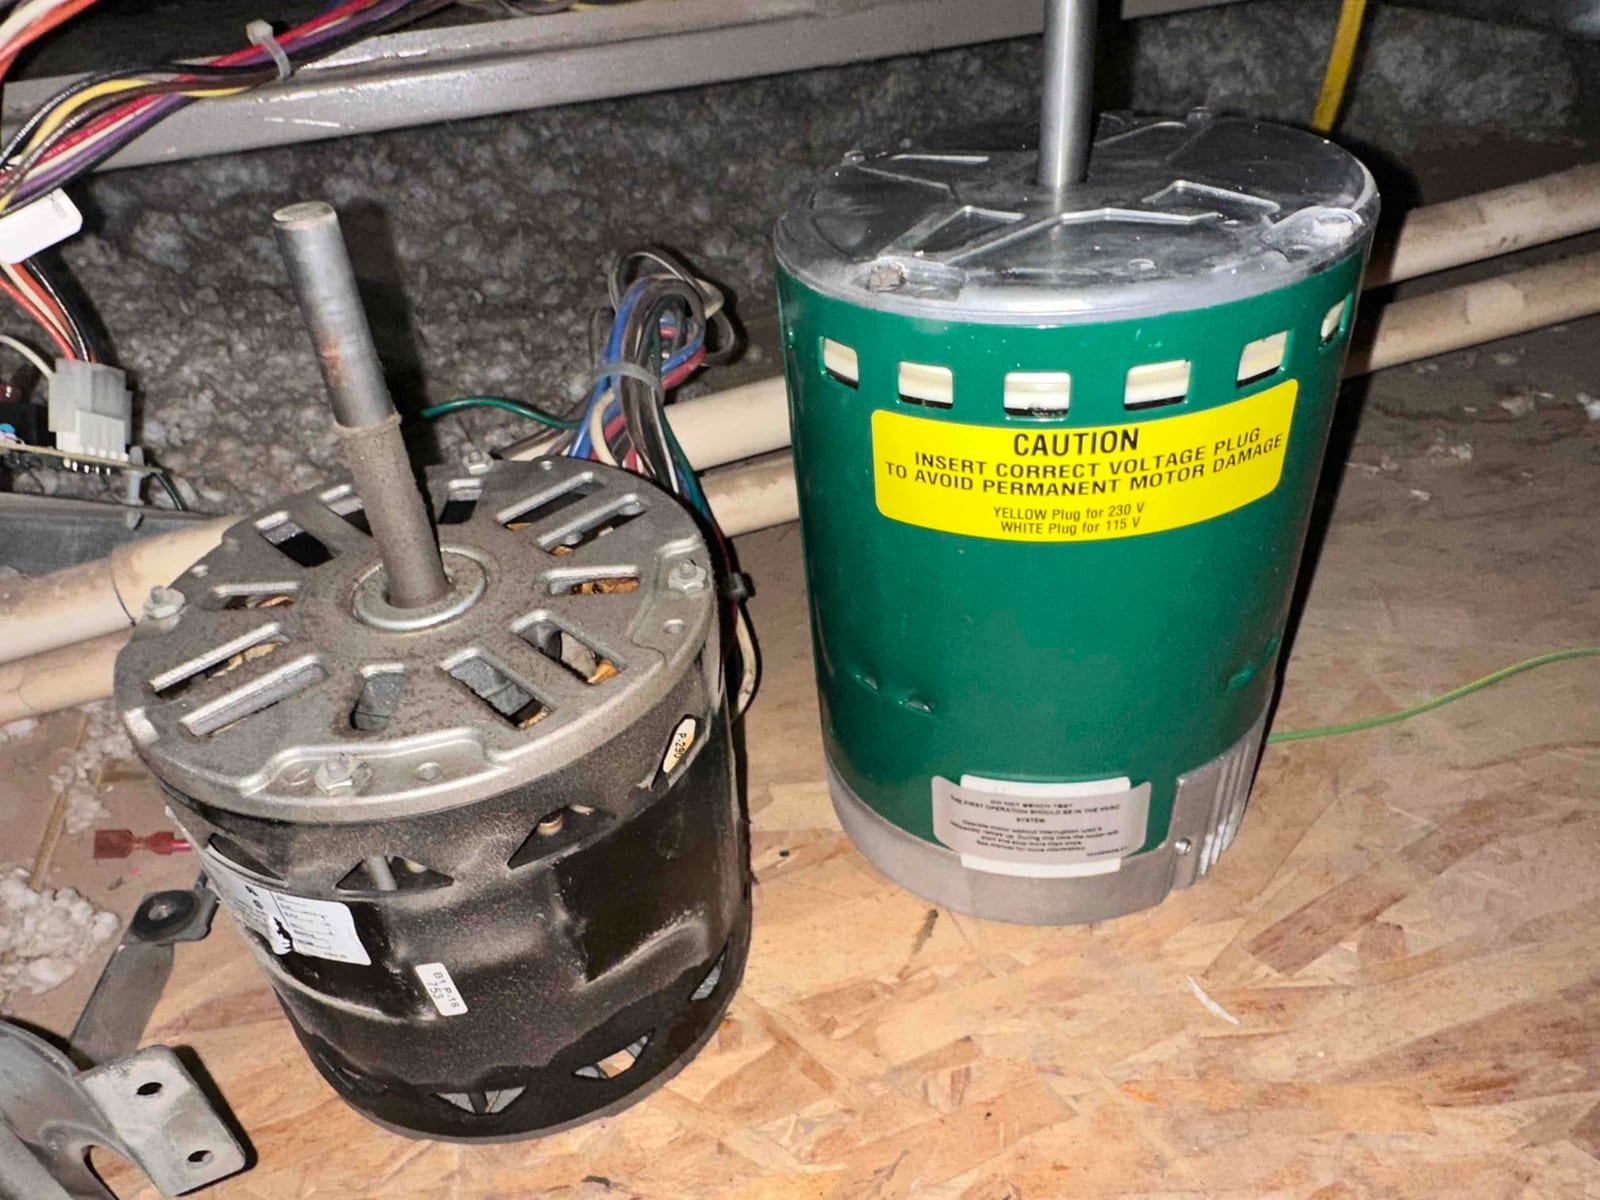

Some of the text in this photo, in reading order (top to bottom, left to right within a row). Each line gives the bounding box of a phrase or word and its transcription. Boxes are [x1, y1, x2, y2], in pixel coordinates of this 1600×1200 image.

[915, 427, 1261, 479] INSERT CORRECT VOLTAGE PLUG
[1013, 427, 1139, 456] CAUTION
[885, 433, 1283, 496] TO AVOID PERMANENT MOTOR DAMAGE
[993, 501, 1145, 522] YELLOW Plug for 230 V
[1000, 516, 1141, 536] WHITE Plug for 115 V
